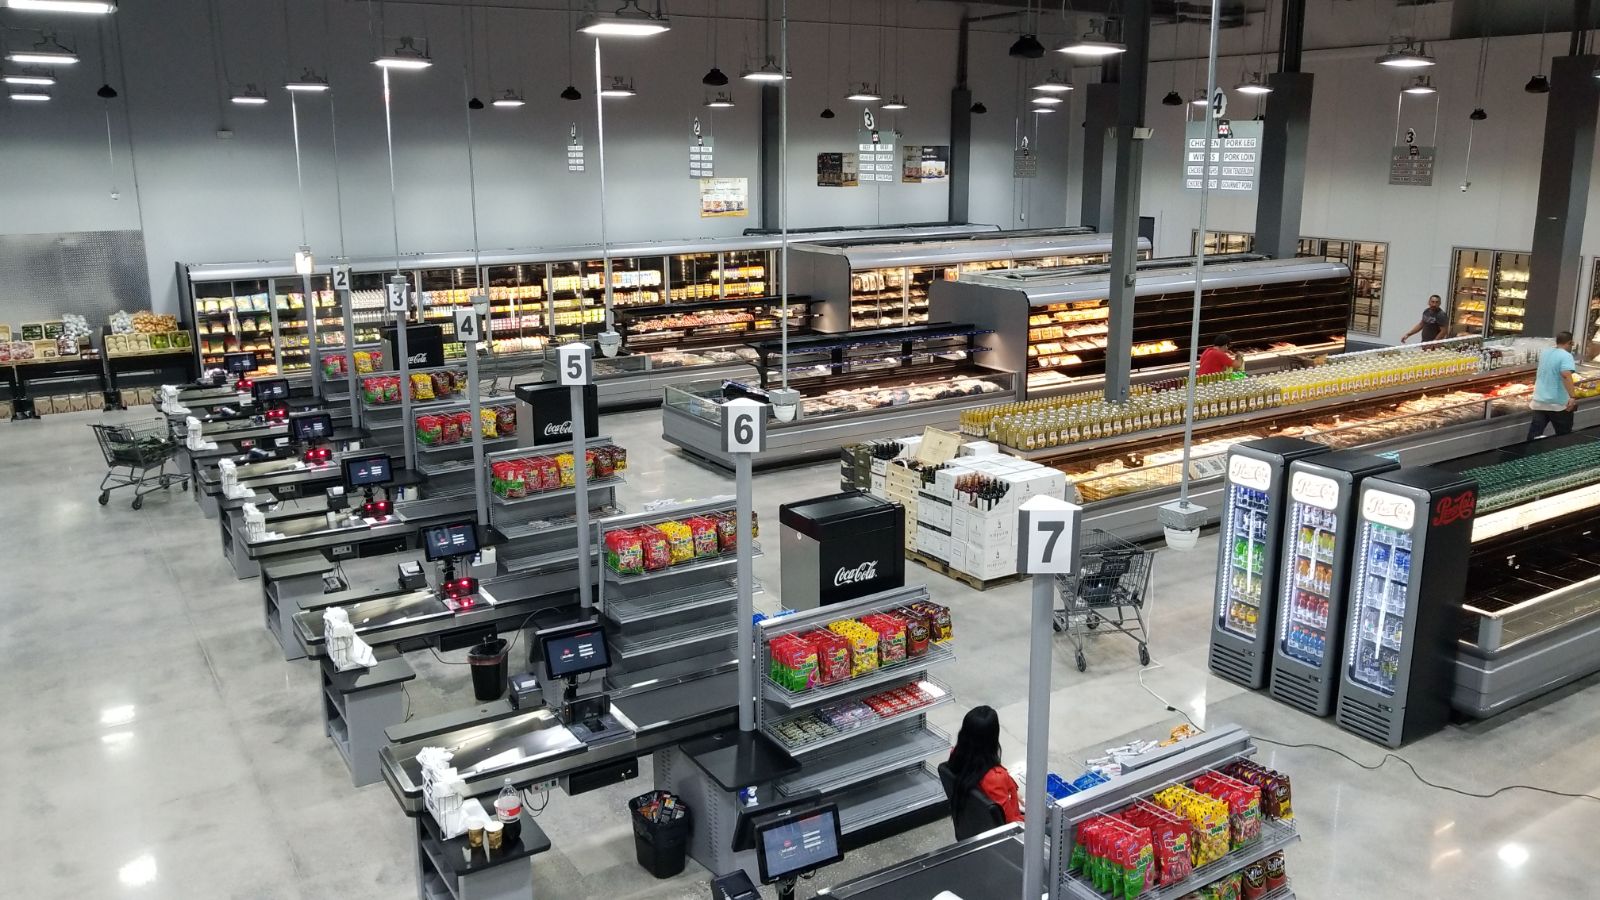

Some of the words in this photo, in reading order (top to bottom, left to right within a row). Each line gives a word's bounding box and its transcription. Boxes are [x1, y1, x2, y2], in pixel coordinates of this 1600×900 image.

[1213, 93, 1222, 114] 4
[694, 120, 700, 132] 2
[865, 112, 872, 127] 3
[1190, 139, 1219, 147] CHICEN
[1226, 139, 1243, 147] PORK
[1244, 139, 1255, 147] LEG
[1406, 132, 1414, 143] 3
[337, 271, 346, 286] 2
[393, 288, 404, 306] 3
[461, 316, 474, 336] 4
[567, 355, 583, 379] 5
[734, 413, 754, 445] 6
[1038, 521, 1065, 564] 7
